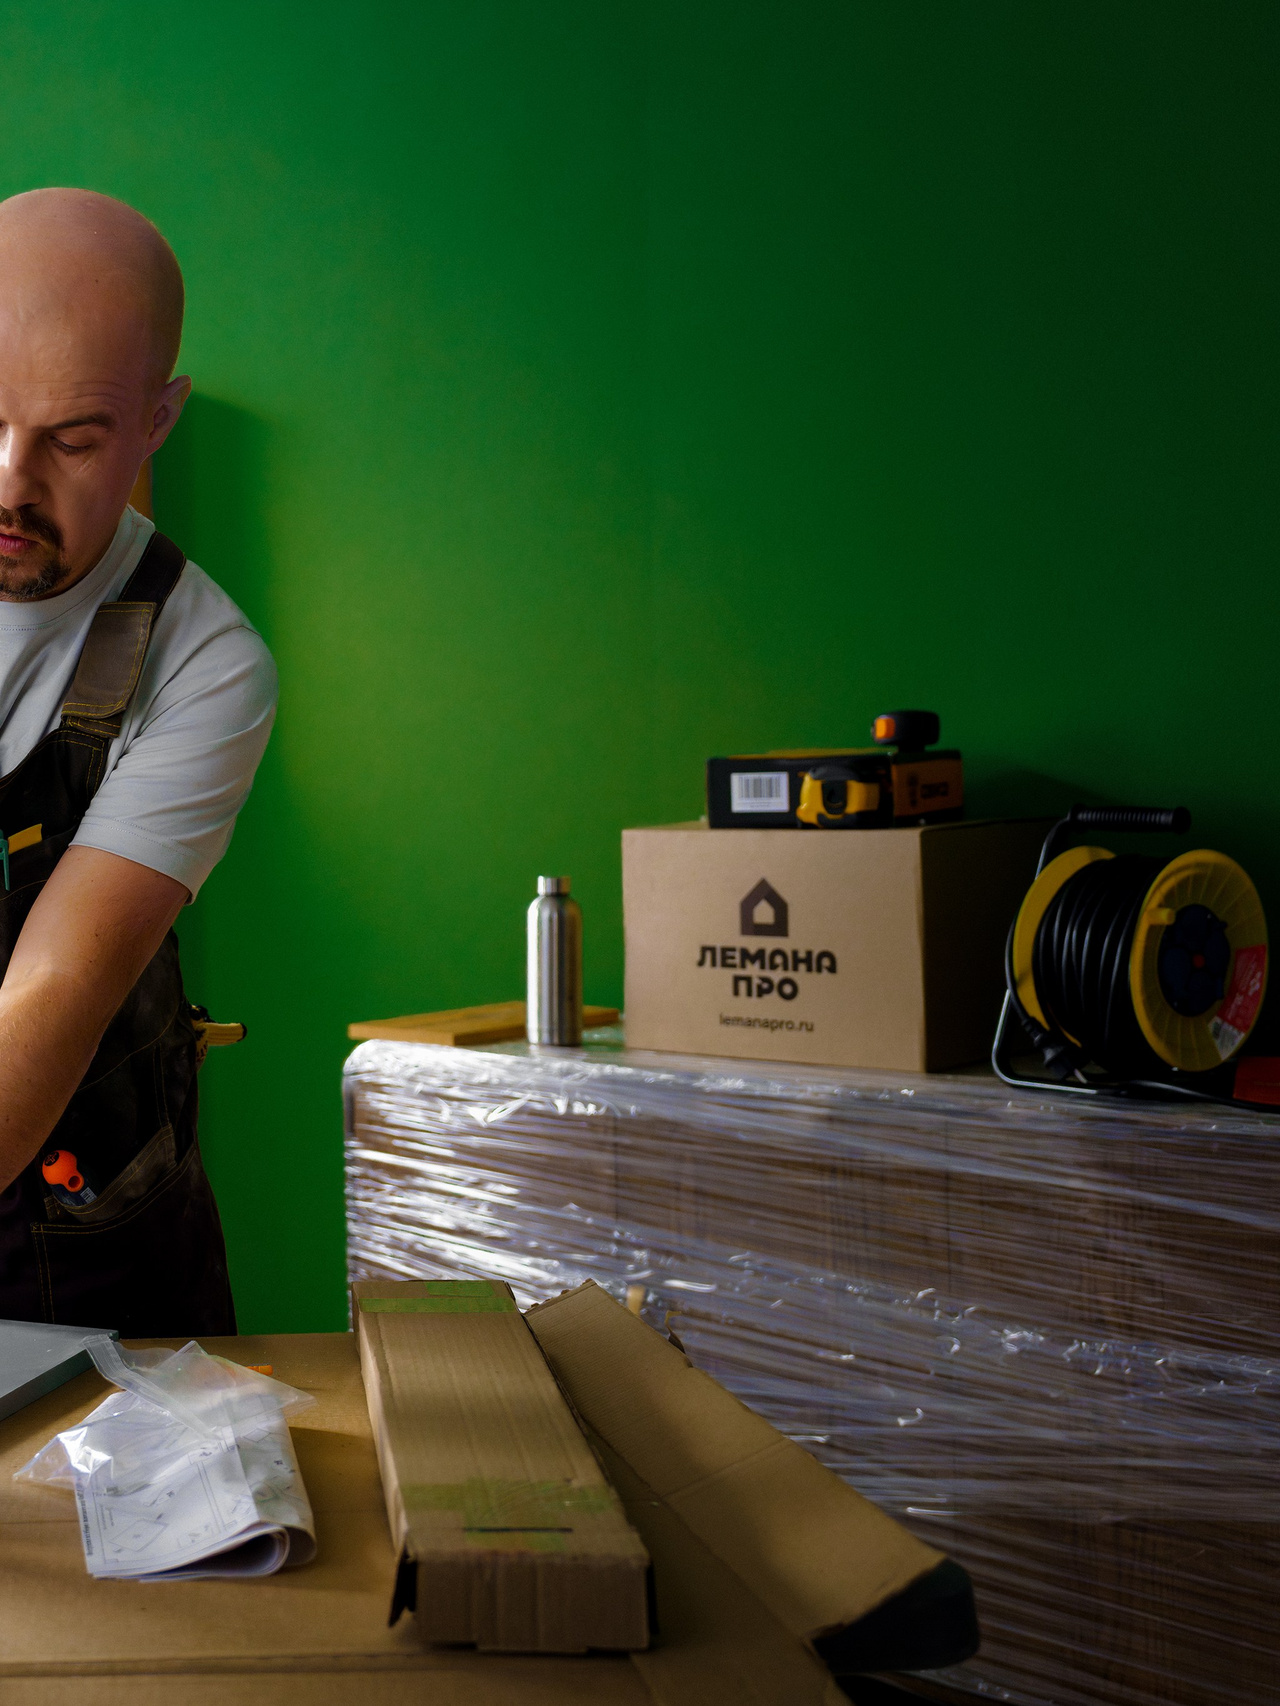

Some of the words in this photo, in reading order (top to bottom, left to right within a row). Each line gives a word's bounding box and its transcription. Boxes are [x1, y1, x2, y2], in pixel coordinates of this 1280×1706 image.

[697, 945, 837, 974] ЛЕМАНА
[733, 974, 798, 1001] ПРО
[719, 1012, 814, 1032] lemanapro.ru
